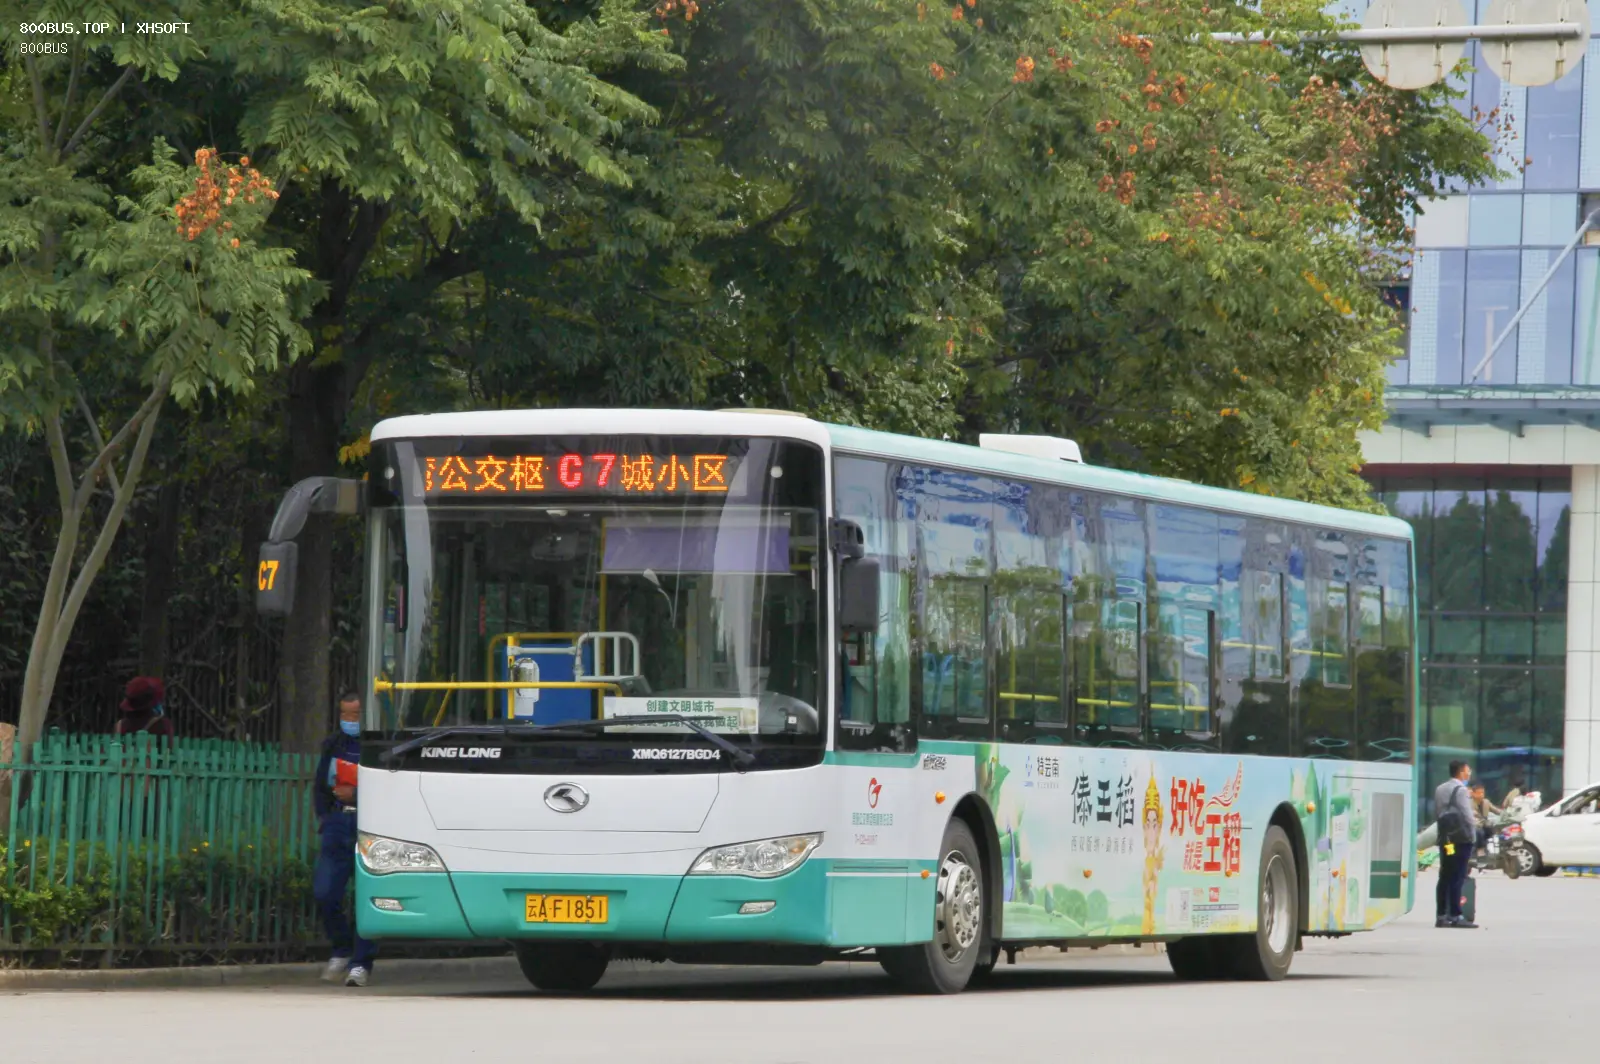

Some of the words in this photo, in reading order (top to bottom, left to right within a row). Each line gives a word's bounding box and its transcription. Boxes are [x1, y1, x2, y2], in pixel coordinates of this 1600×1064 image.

[621, 454, 729, 491] 城小区
[258, 560, 280, 591] C7
[646, 699, 715, 713] 创建文明城市
[420, 747, 458, 759] KING
[458, 747, 502, 759] LONG
[632, 748, 721, 761] XMQ6127BGD4
[1070, 769, 1135, 829] 傣王稻
[1170, 776, 1205, 836] 好吃
[1203, 812, 1241, 873] 王稻
